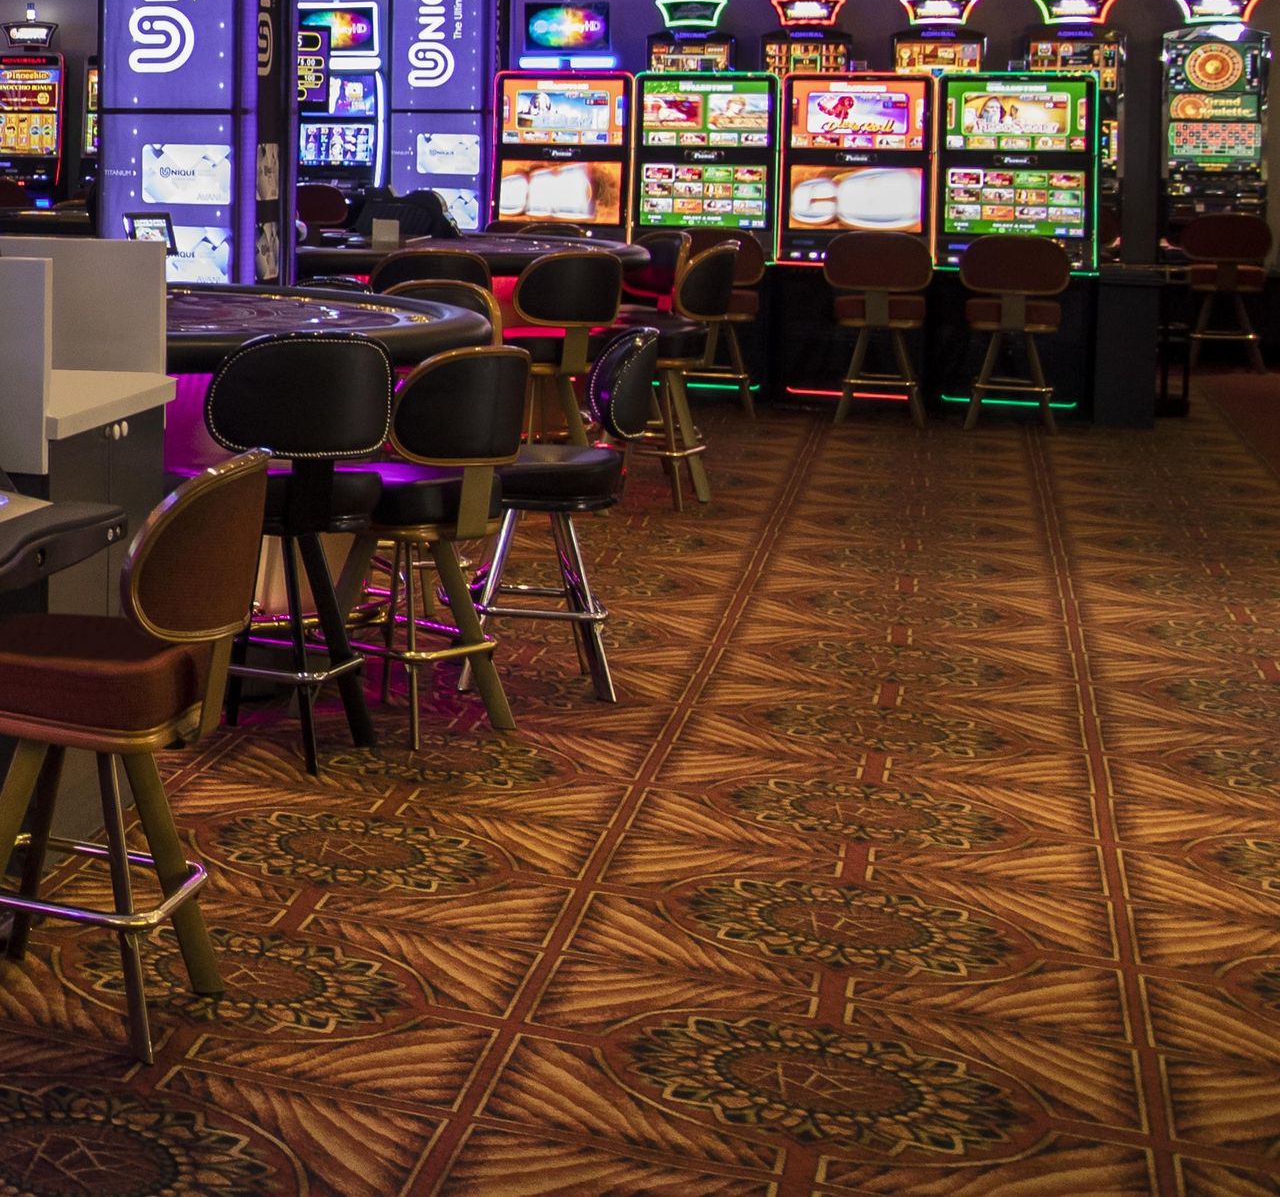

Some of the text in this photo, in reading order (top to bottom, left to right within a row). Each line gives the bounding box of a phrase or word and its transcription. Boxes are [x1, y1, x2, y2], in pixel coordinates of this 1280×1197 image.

[453, 20, 462, 40] The
[6, 70, 49, 81] Pinocchio
[1205, 97, 1241, 107] Grand
[1199, 106, 1256, 118] Roulette
